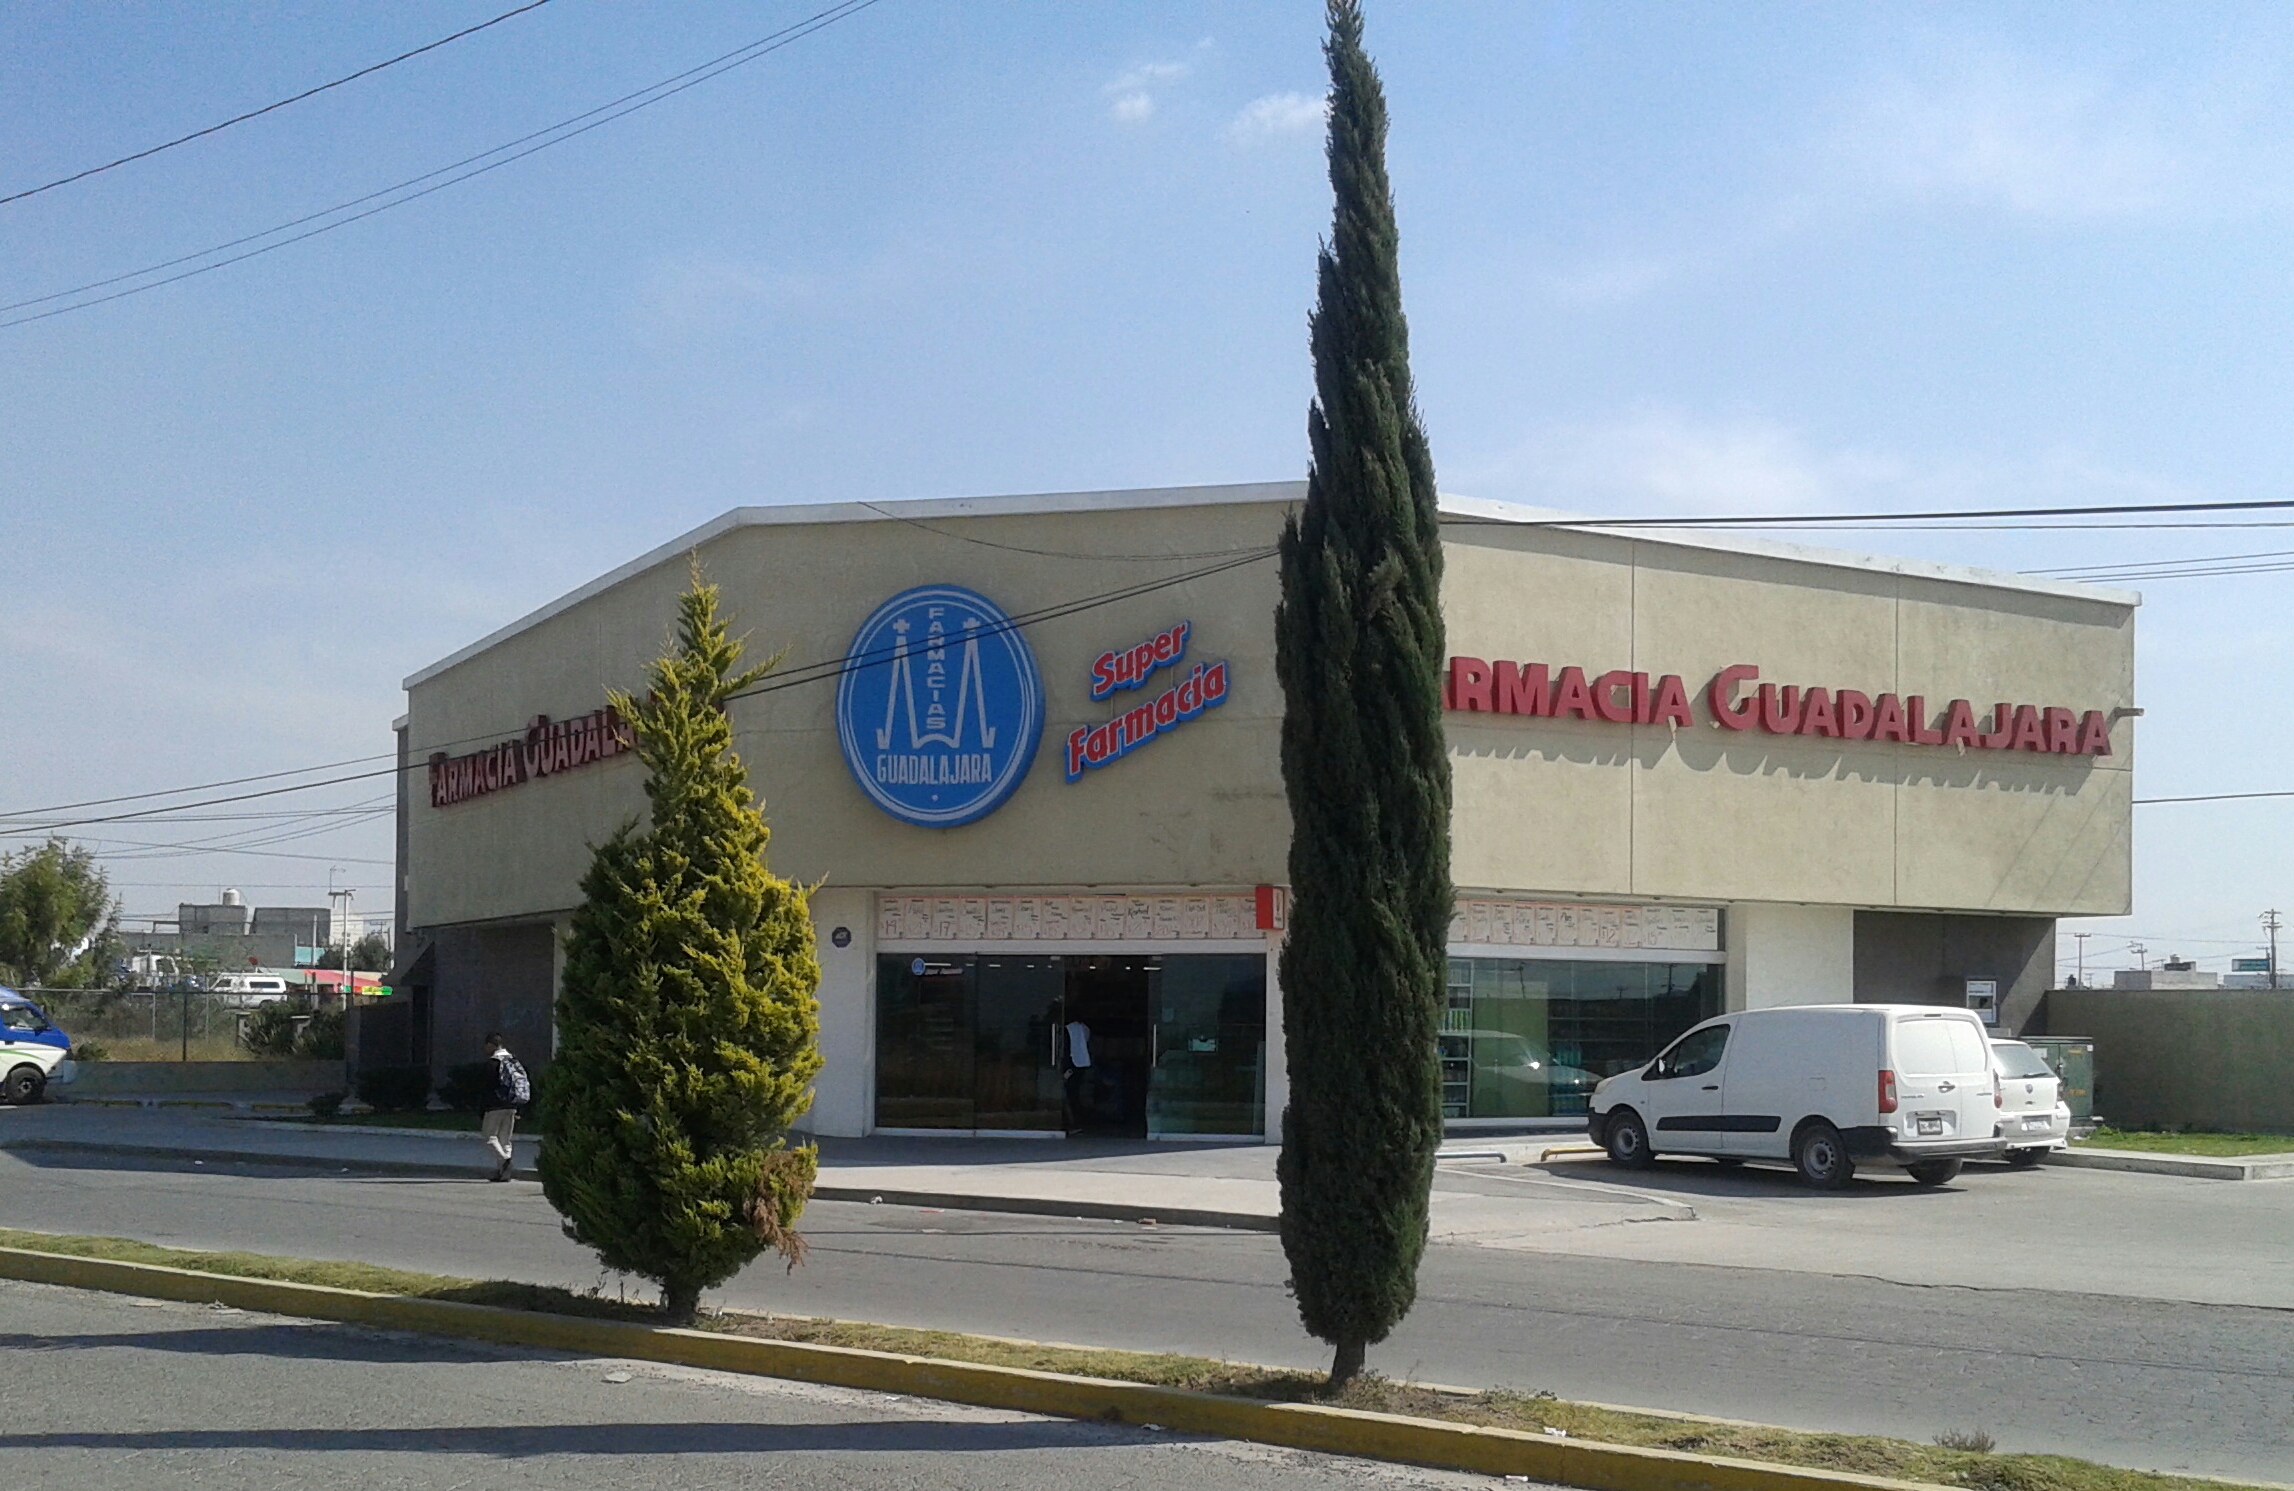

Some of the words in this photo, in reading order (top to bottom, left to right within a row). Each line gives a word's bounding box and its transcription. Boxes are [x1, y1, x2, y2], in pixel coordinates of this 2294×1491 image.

[927, 606, 947, 730] FARMACIAS
[1091, 621, 1189, 696] Super
[523, 705, 636, 778] GUADALA
[1067, 660, 1229, 777] Farmacia
[1442, 656, 1695, 727] RMACIA
[1707, 664, 2111, 755] GUADALAJARA
[876, 752, 992, 786] GUADALAJARA
